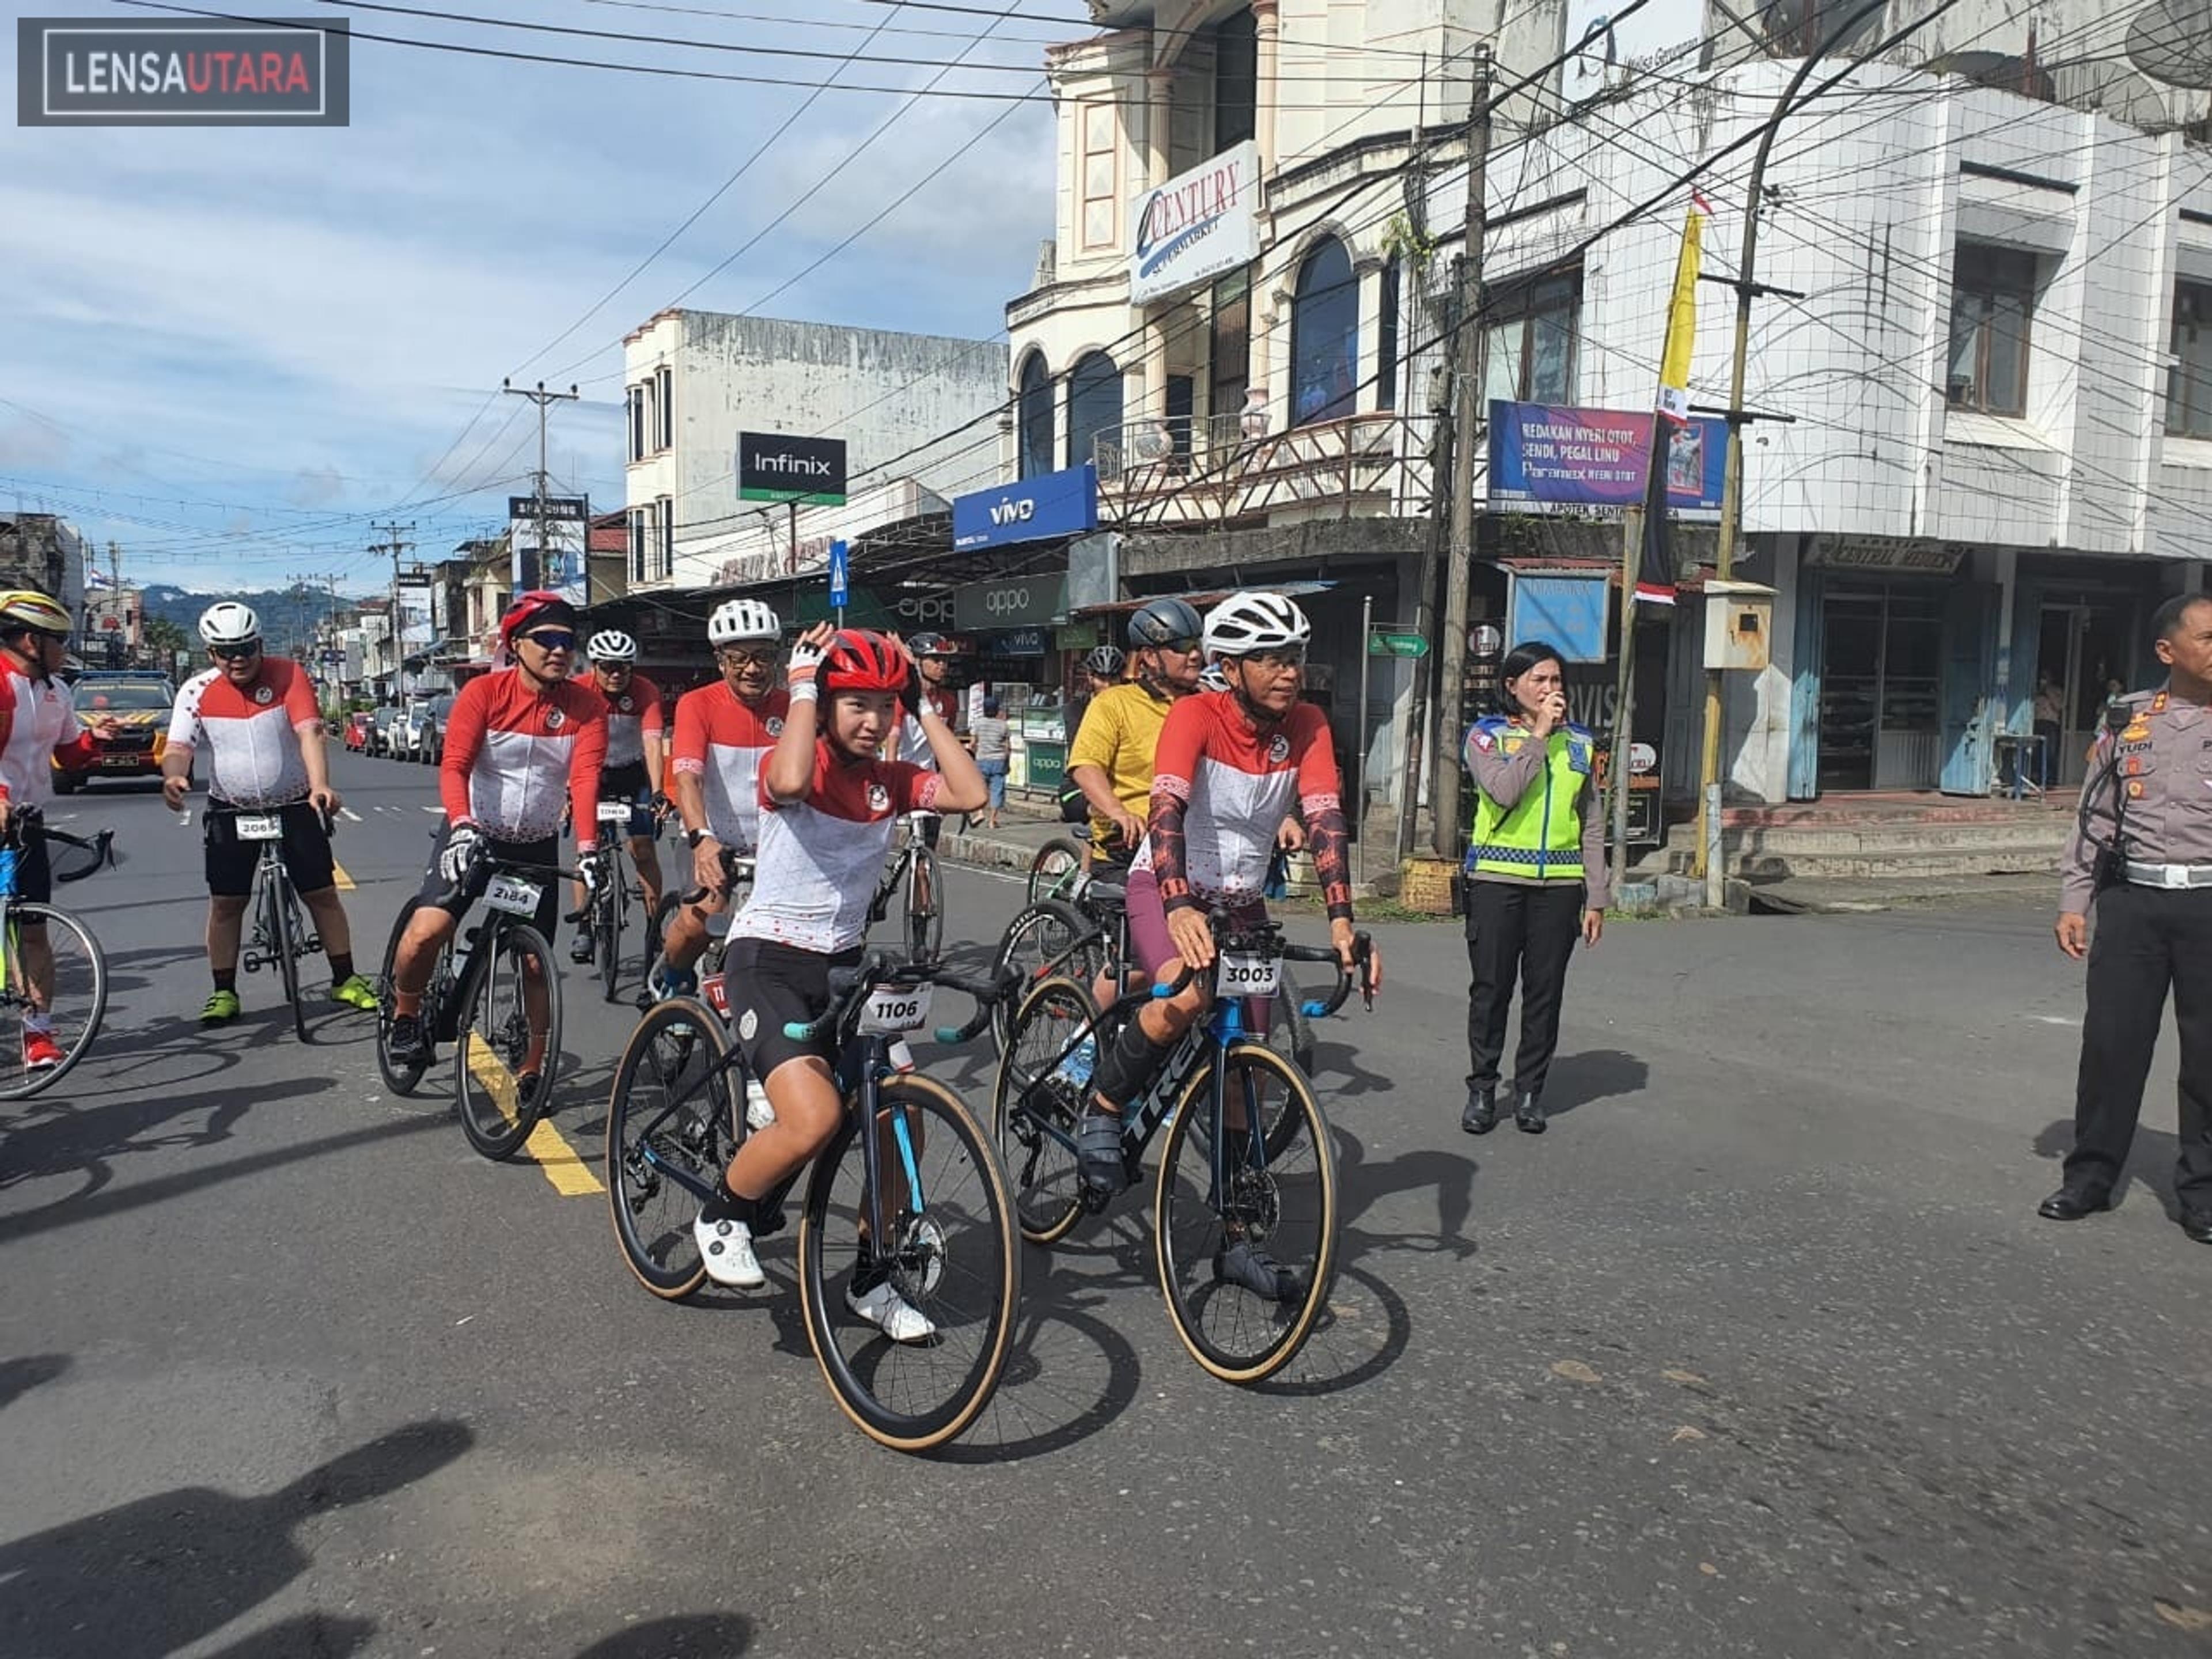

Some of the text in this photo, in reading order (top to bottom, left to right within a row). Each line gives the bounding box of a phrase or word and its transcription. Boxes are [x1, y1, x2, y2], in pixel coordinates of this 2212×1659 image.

[1150, 160, 1241, 243] CENTURY
[1522, 423, 1573, 441] REDAKAN
[1575, 427, 1605, 443] NYERI
[1560, 445, 1593, 461] PEGAL
[1594, 447, 1620, 463] LINU
[755, 452, 831, 476] Infinix
[989, 497, 1035, 525] vivo
[898, 596, 956, 623] opp
[986, 588, 1029, 616] oppo
[1014, 632, 1039, 647] vivo
[2119, 741, 2153, 754] YUDI
[494, 887, 528, 904] 2184
[1226, 967, 1274, 982] 3003
[877, 1000, 918, 1018] 1106
